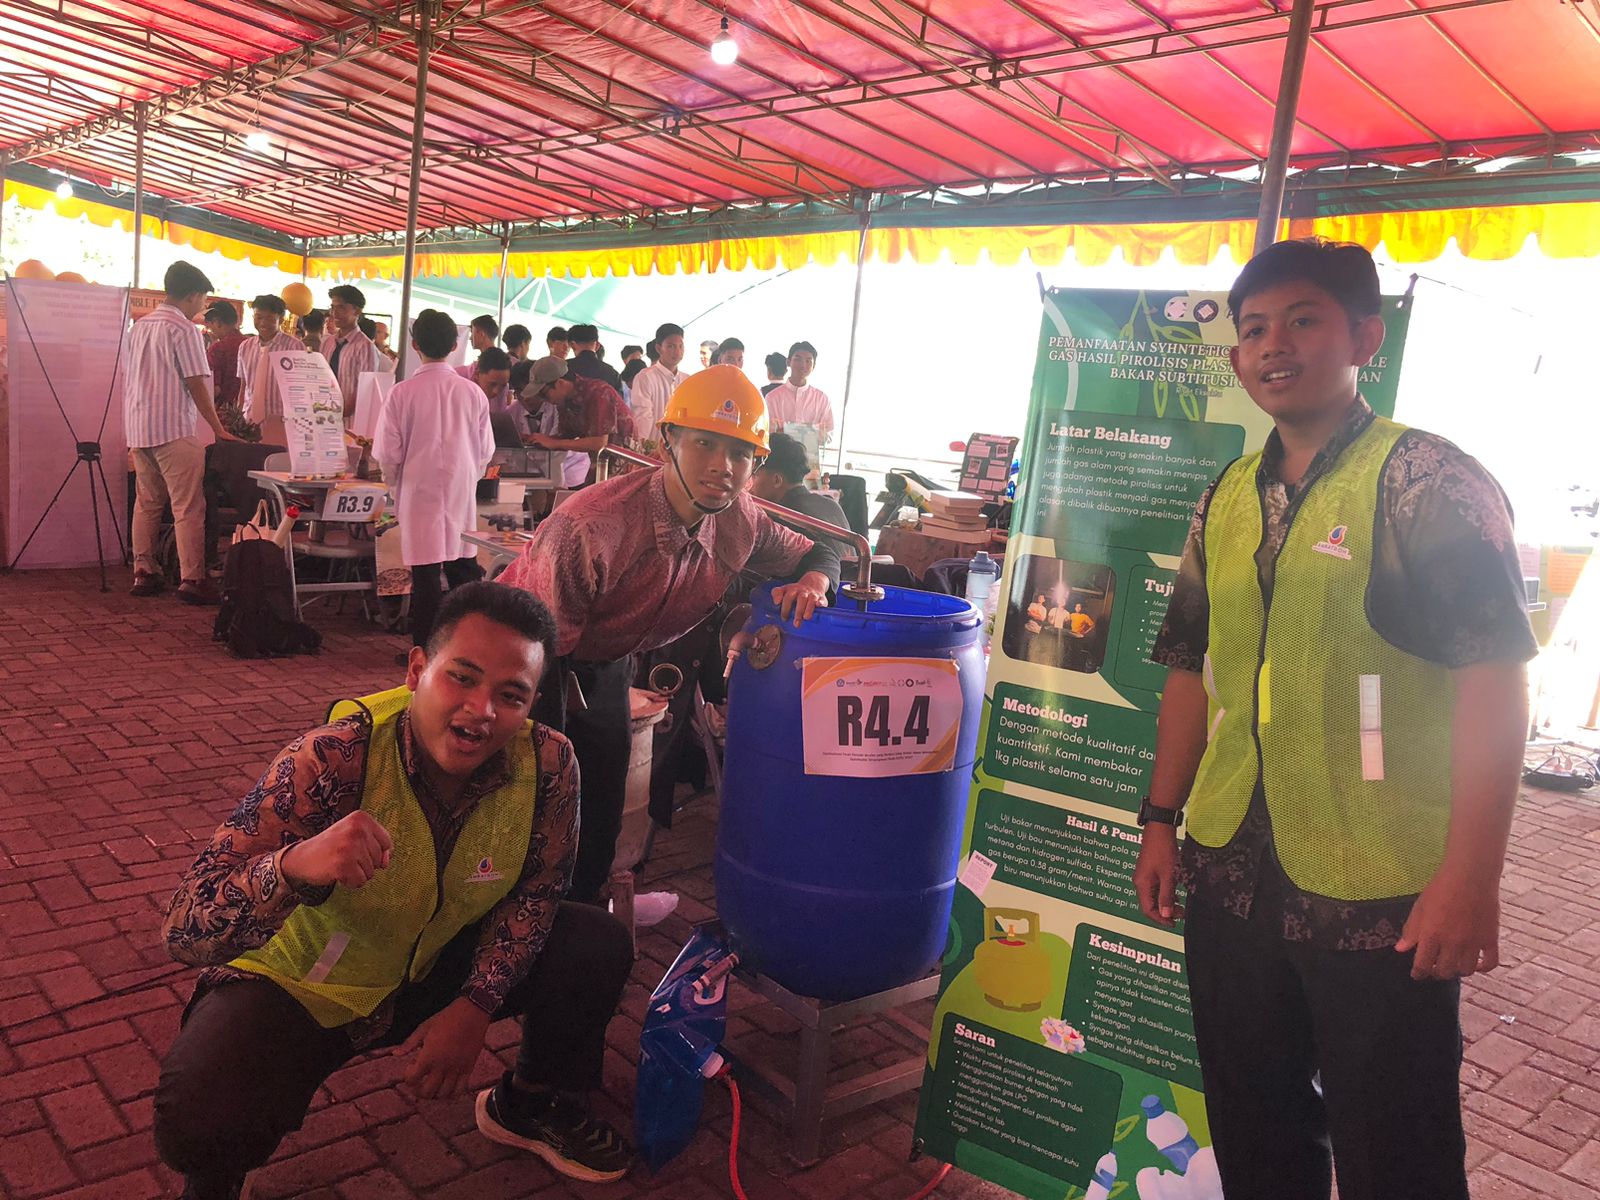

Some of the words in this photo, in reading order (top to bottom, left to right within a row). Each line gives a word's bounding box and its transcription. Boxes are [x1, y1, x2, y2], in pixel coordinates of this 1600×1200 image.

[1048, 336, 1145, 352] PEMANFAATAN
[1150, 342, 1232, 357] SYHNTETIC
[1048, 350, 1074, 361] GAS
[1076, 351, 1116, 364] HASIL
[1120, 355, 1188, 369] PIROLISIS
[1358, 371, 1382, 382] AN
[1110, 368, 1154, 381] BAKAR
[1158, 370, 1234, 387] SUBTITUSI
[1050, 423, 1090, 438] Latar
[1094, 426, 1172, 449] Belakang
[1047, 443, 1075, 452] Jumlah
[1077, 446, 1104, 456] plastik
[1106, 450, 1126, 460] yang
[1129, 451, 1162, 462] semakin
[1166, 454, 1196, 467] banyak
[1200, 458, 1216, 467] dan
[1042, 470, 1060, 480] juga
[1064, 472, 1094, 483] adanya
[1096, 475, 1128, 486] metode
[1130, 479, 1162, 490] pirolisis
[1164, 483, 1188, 493] untuk
[1044, 457, 1072, 467] jumlah
[1074, 460, 1088, 470] gas
[1091, 460, 1112, 470] alam
[1114, 464, 1134, 474] yang
[1137, 464, 1172, 477] semakin
[1174, 469, 1208, 482] menipis
[336, 496, 374, 513] R3.9
[1039, 497, 1066, 506] alasan
[1068, 498, 1094, 510] dibalik
[1097, 501, 1138, 516] dibuatnya
[1140, 507, 1184, 520] penelitian
[1041, 483, 1084, 496] mengubah
[1086, 486, 1112, 498] plastik
[1115, 490, 1148, 503] menjadi
[1151, 496, 1167, 506] gas
[838, 696, 930, 746] R4.4
[1002, 697, 1088, 728] Metodologi
[1000, 716, 1040, 734] Dengan
[1042, 726, 1084, 745] metode
[1087, 736, 1136, 756] kualitatif
[997, 733, 1052, 756] kuantitatif.
[1055, 746, 1082, 762] Kami
[1084, 751, 1144, 778] membakar
[994, 750, 1010, 765] 1kg
[1012, 754, 1046, 772] plastik
[1048, 764, 1088, 782] selama
[1090, 774, 1114, 788] satu
[1116, 780, 1138, 795] jam
[1000, 814, 1010, 824] Uji
[1012, 816, 1032, 828] bakar
[1034, 821, 1082, 843] menunjukkan
[1084, 832, 1109, 850] bahwa
[1112, 840, 1129, 855] pola
[1066, 815, 1098, 832] Hasil
[1100, 824, 1108, 835] &
[984, 822, 1015, 838] turbulen.
[1017, 830, 1027, 841] Uji
[1028, 833, 1043, 844] bau
[1045, 838, 1092, 858] menunjukkan
[1094, 848, 1120, 866] bahwa
[988, 835, 1014, 848] metana
[1016, 841, 1030, 853] dan
[1032, 846, 1065, 864] hidrogen
[1066, 854, 1094, 872] sulfida.
[975, 854, 993, 868] REPORT
[988, 848, 1001, 858] gas
[1003, 852, 1030, 868] berupa
[1048, 863, 1095, 884] gram/menit.
[1097, 878, 1122, 894] Warna
[1124, 886, 1136, 897] api
[1004, 864, 1018, 874] biru
[1020, 869, 1066, 889] menunjukkan
[1068, 883, 1094, 899] bahwa
[1096, 892, 1114, 904] suhu
[1115, 897, 1129, 908] api
[1130, 901, 1139, 910] ini
[1087, 951, 1102, 962] Dari
[1103, 958, 1137, 974] penelitian
[1149, 972, 1171, 984] dapat
[1089, 934, 1182, 973] Kesimpulan
[1098, 967, 1112, 978] Gas
[1114, 972, 1132, 985] yang
[1133, 978, 1168, 995] dihasilkan
[1095, 990, 1132, 1008] menyengat
[1096, 980, 1120, 992] apinya
[1122, 986, 1139, 998] tidak
[1140, 992, 1173, 1009] konsisten
[1174, 1003, 1189, 1014] dan
[954, 1022, 996, 1048] Saran
[1090, 1011, 1130, 1031] kekurangan
[1092, 1000, 1117, 1014] Syngas
[1119, 1010, 1136, 1022] yang
[1138, 1016, 1173, 1033] dihasilkan
[1175, 1028, 1196, 1042] punya
[1087, 1034, 1114, 1049] sebagai
[1116, 1045, 1145, 1060] subtitusi
[1146, 1055, 1160, 1066] gas
[1089, 1022, 1113, 1036] Syngas
[1114, 1032, 1132, 1044] yang
[1134, 1038, 1168, 1056] dihasilkan
[1170, 1051, 1194, 1064] belum
[1004, 1056, 1036, 1072] penelitian
[1025, 1084, 1049, 1100] dengan
[1050, 1096, 1066, 1108] yang
[1027, 1074, 1034, 1082] di
[1035, 1078, 1058, 1092] tambah
[1060, 1121, 1078, 1134] agar
[1000, 1131, 1016, 1144] yang
[1064, 1156, 1080, 1168] suhu
